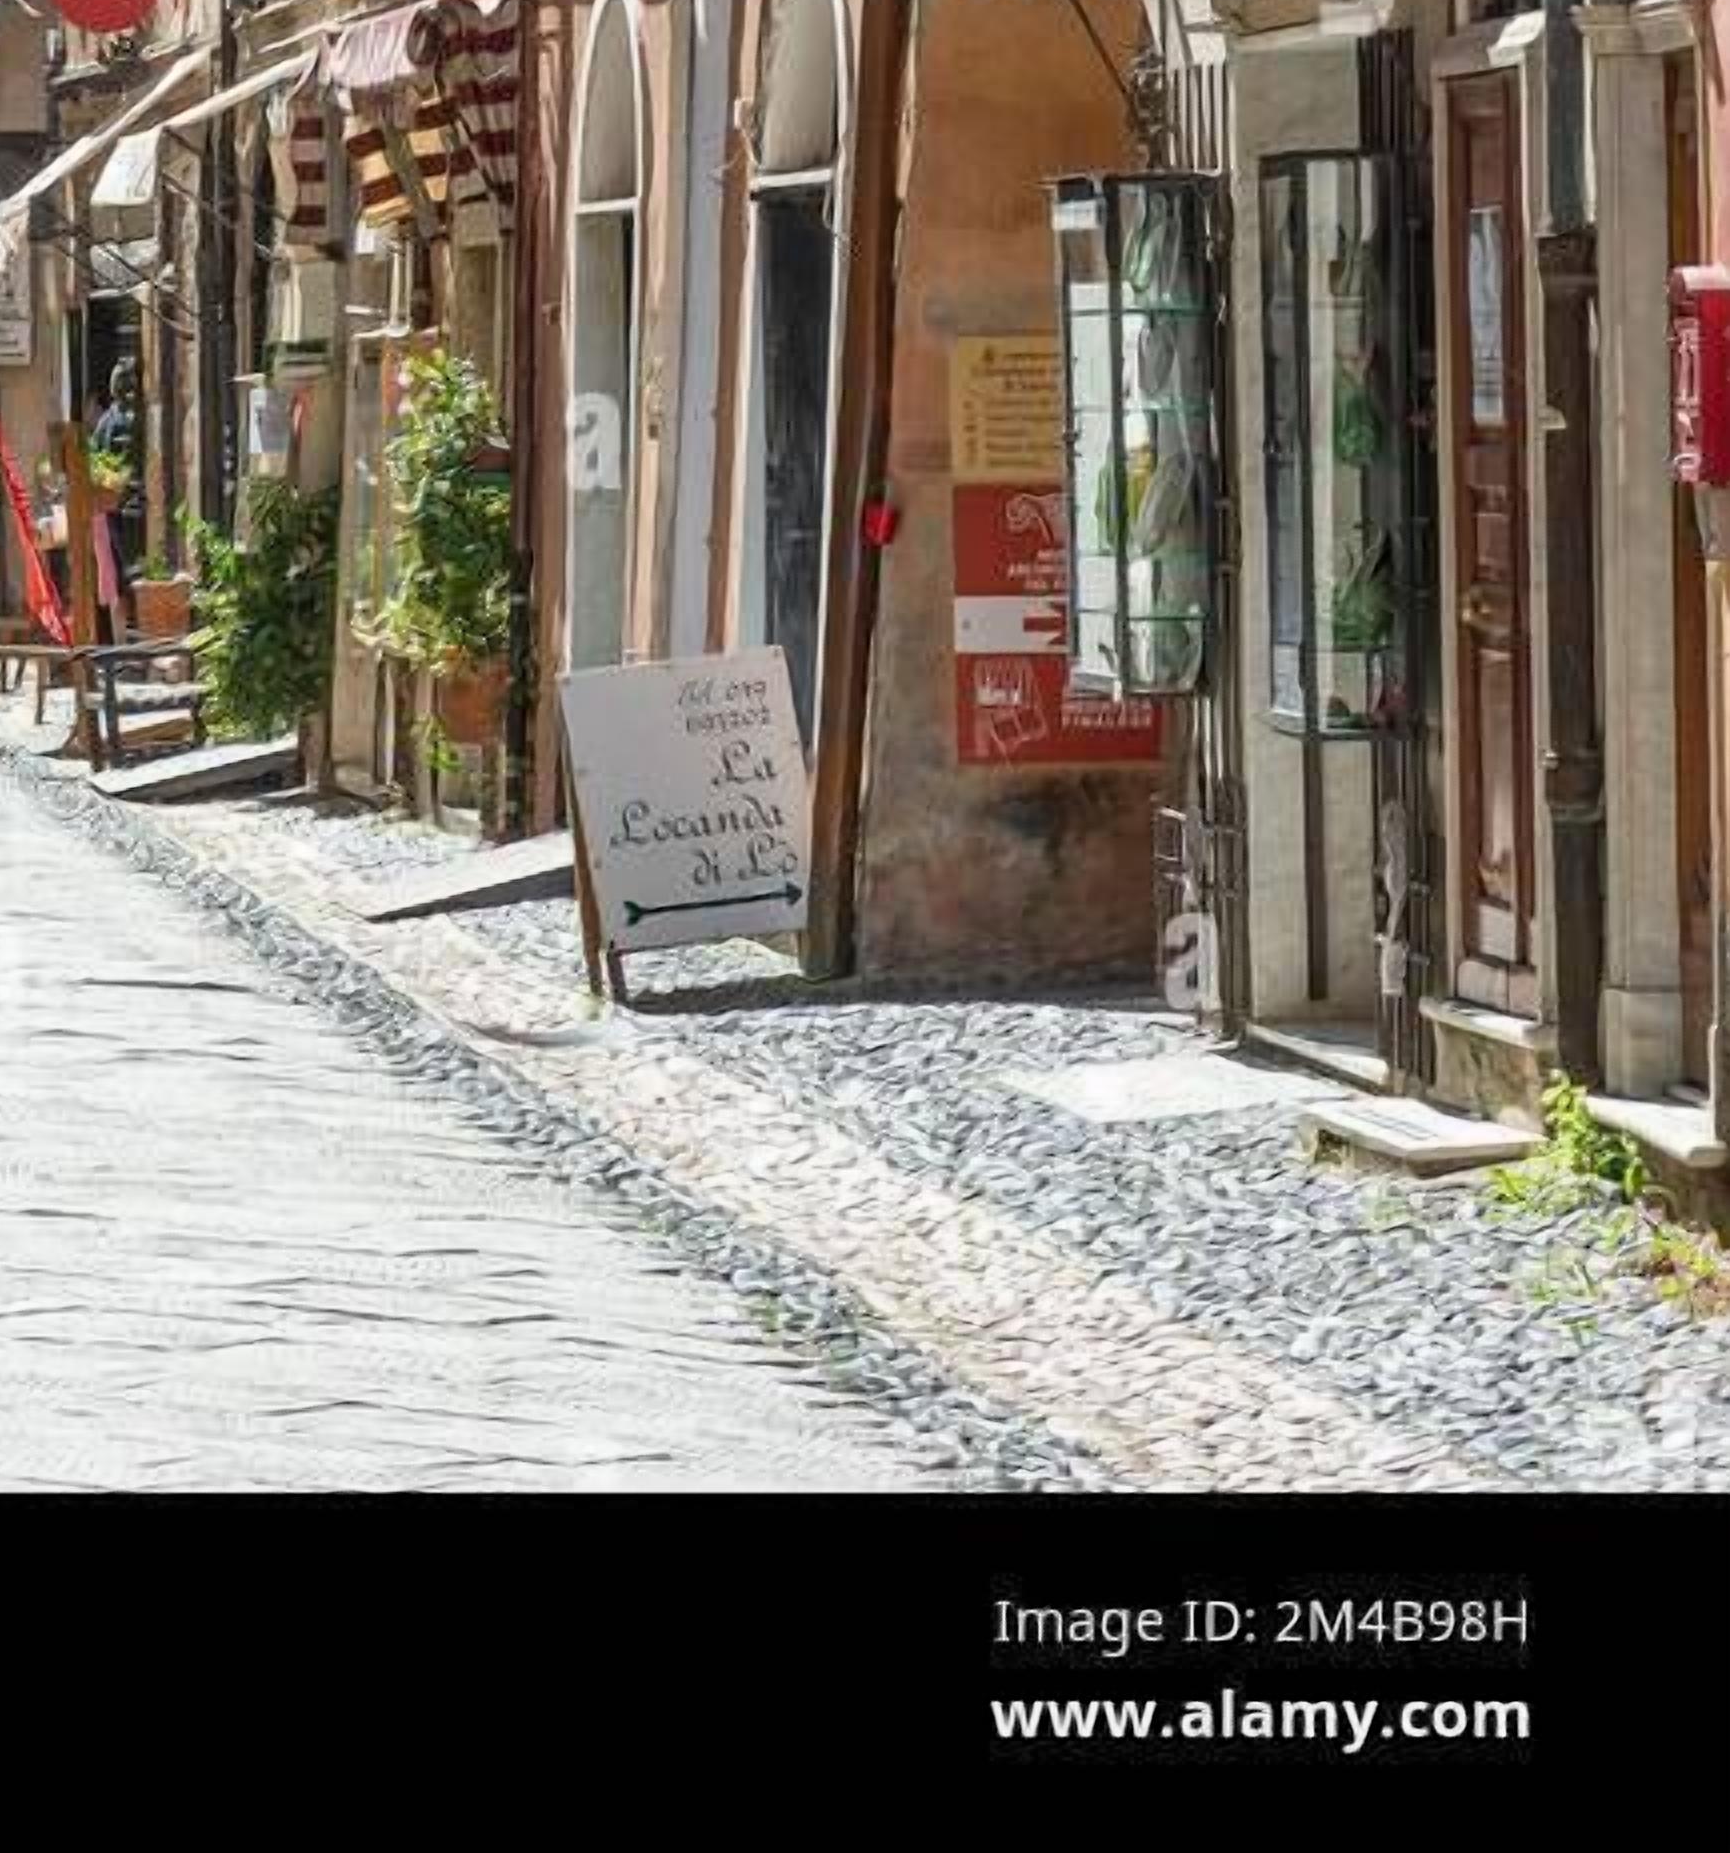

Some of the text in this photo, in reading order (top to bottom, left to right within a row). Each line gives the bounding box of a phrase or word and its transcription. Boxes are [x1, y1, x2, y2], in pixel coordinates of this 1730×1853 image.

[711, 739, 778, 786] La
[607, 793, 785, 847] Locanda
[692, 849, 722, 886] di
